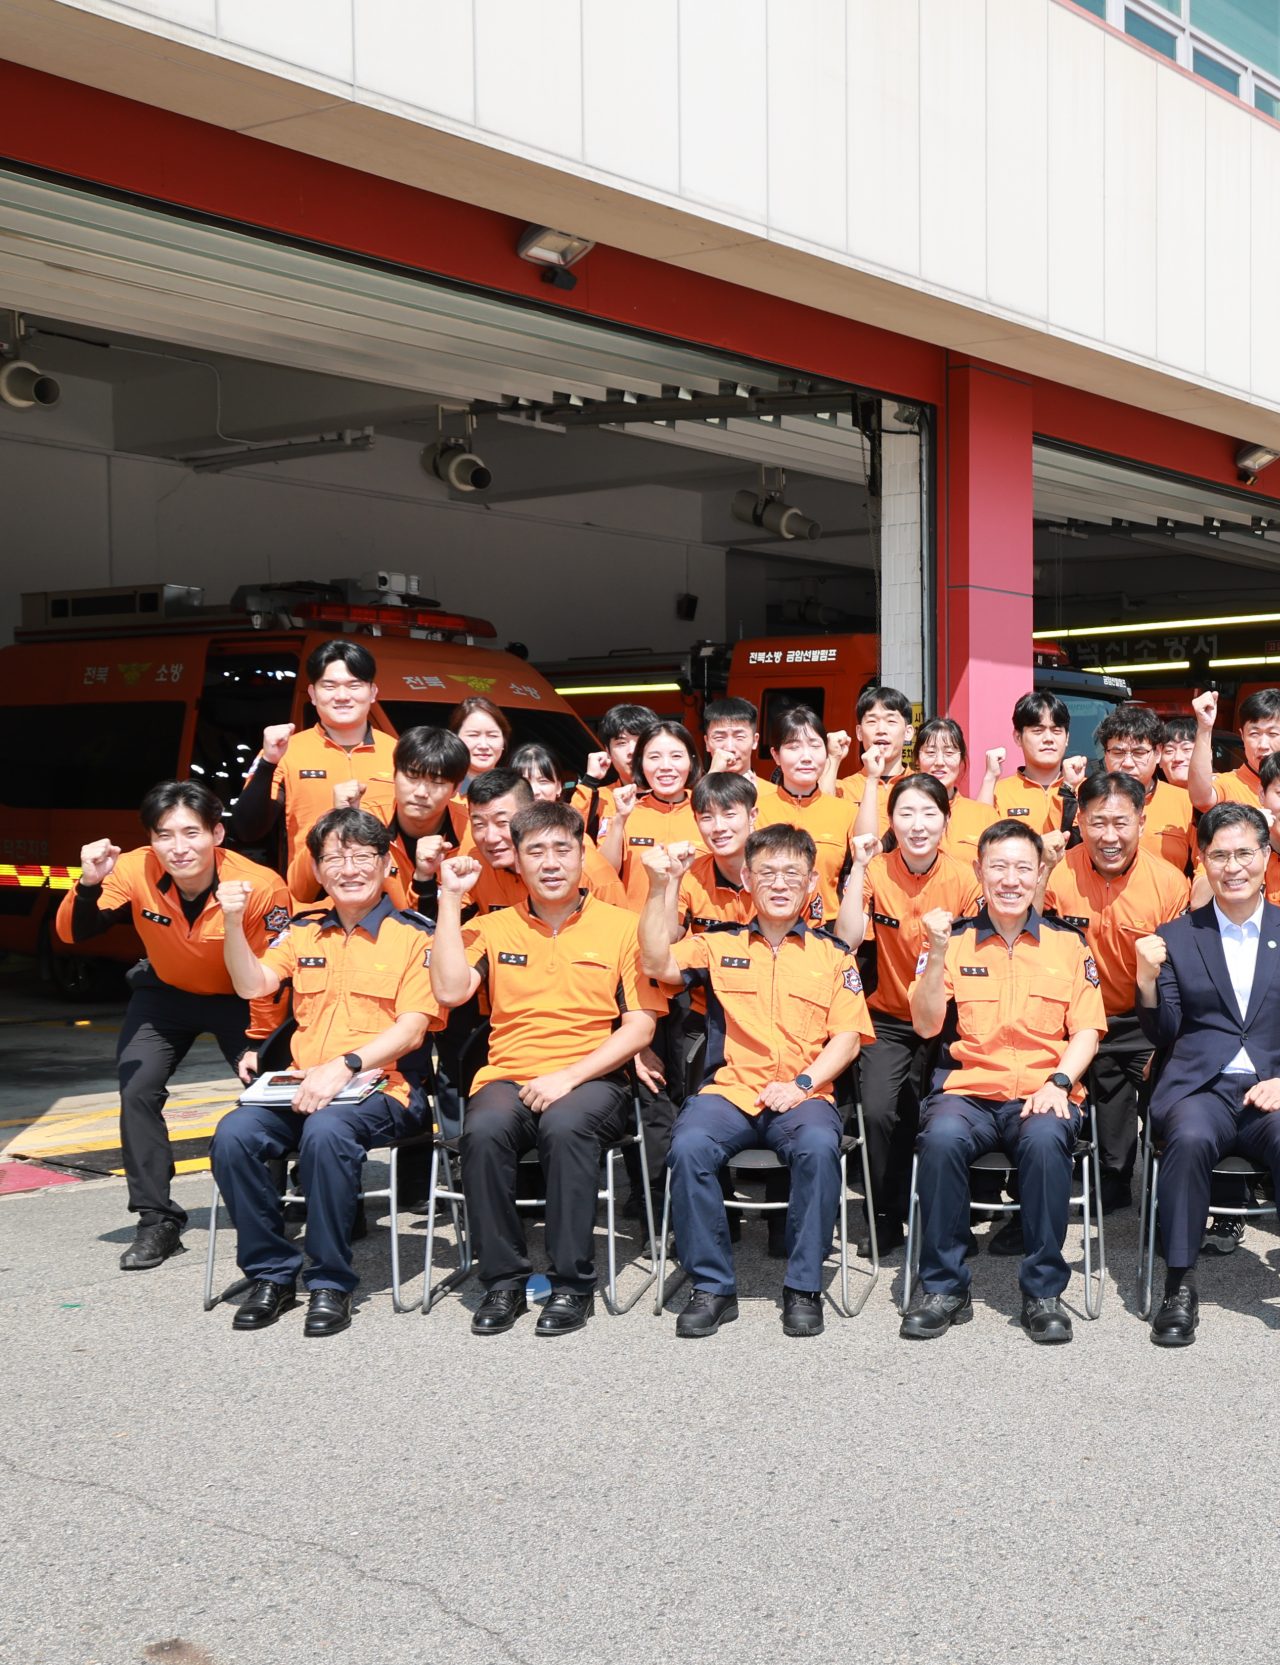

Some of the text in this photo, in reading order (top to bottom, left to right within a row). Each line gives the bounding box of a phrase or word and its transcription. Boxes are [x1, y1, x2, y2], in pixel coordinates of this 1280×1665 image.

[749, 651, 782, 664] 전북소방
[83, 663, 183, 684] 전북 소방
[402, 675, 541, 699] 전북 소방
